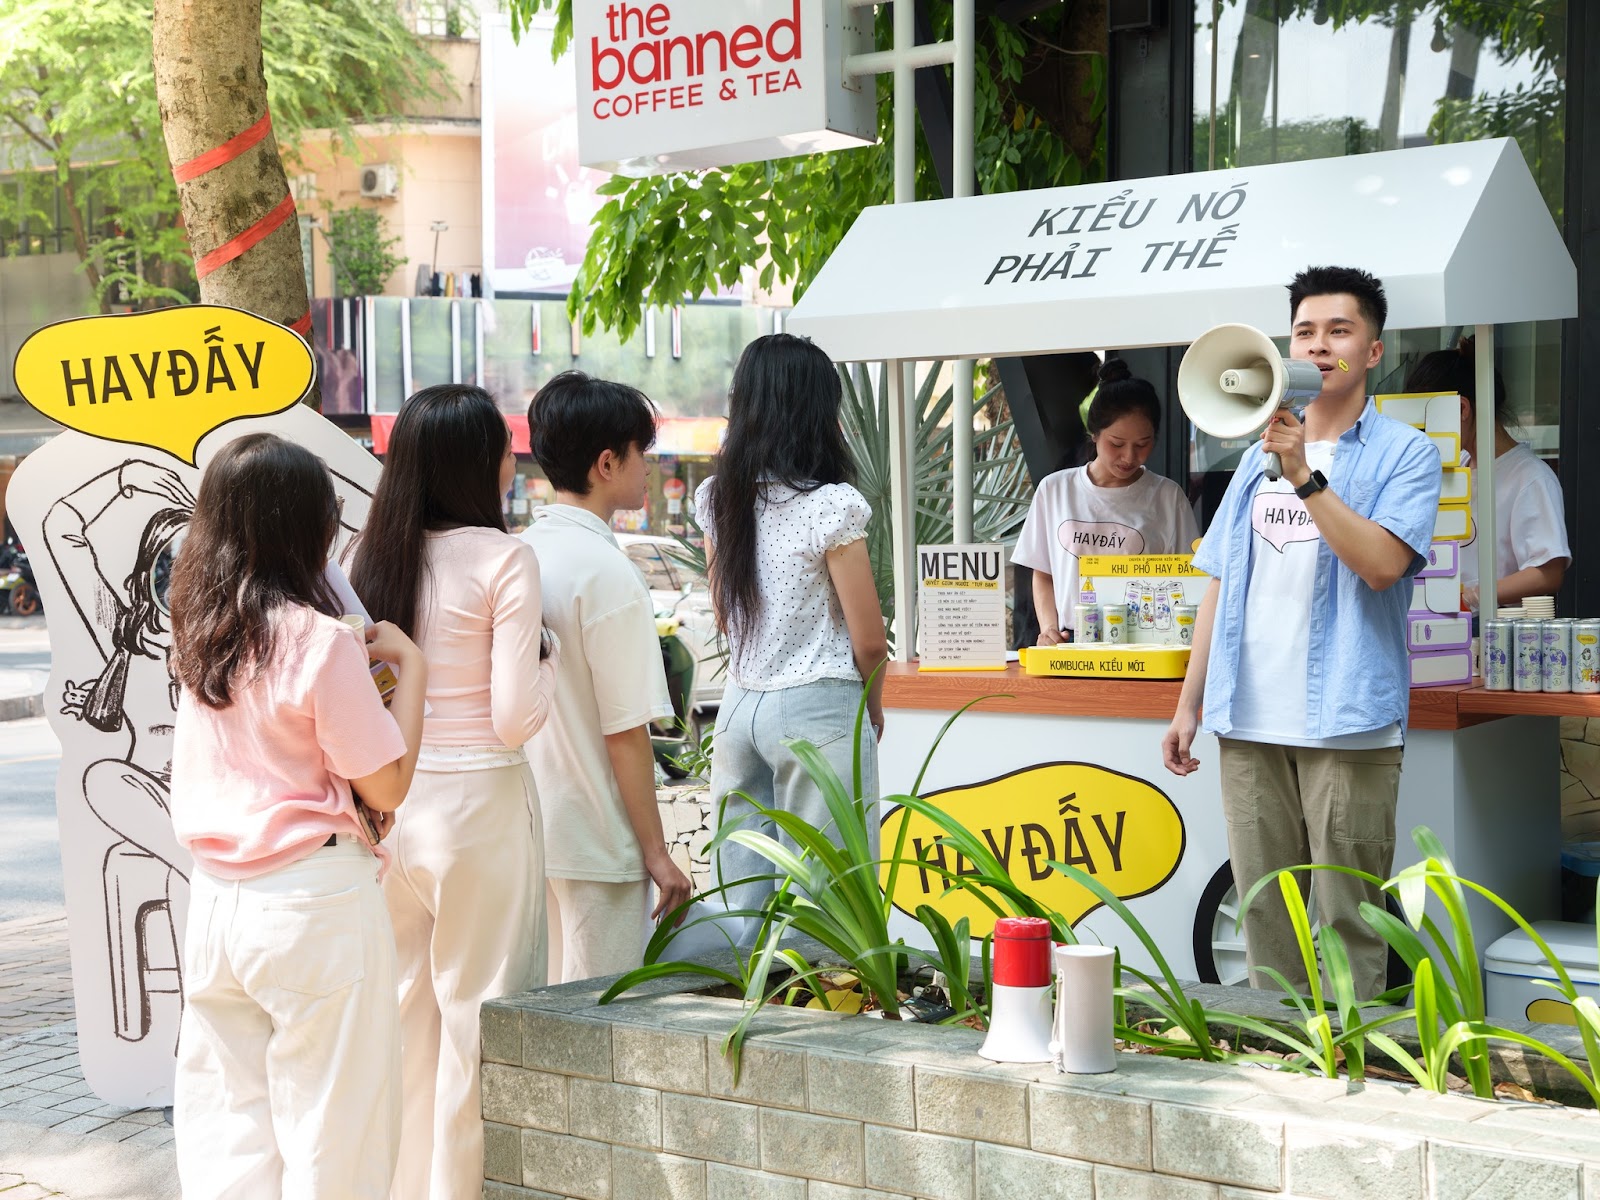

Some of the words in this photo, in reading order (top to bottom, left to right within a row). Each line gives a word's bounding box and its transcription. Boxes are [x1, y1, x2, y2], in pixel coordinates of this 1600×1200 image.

[606, 2, 670, 42] the
[592, 0, 801, 91] banned
[593, 83, 703, 120] COFFEE
[719, 78, 737, 101] &
[747, 68, 801, 96] TEA
[1028, 189, 1158, 237] KIỂU
[1176, 181, 1249, 224] NÓ
[984, 242, 1112, 285] PHẢI
[1140, 223, 1240, 273] THẾ
[60, 325, 265, 406] HAYĐẤY
[1264, 508, 1314, 526] HAYĐ
[1073, 531, 1126, 549] HAYĐẤY
[921, 552, 999, 580] MENU
[1111, 564, 1128, 574] KHU
[1133, 561, 1151, 574] PHỐ
[1155, 564, 1173, 574] HAY
[1050, 660, 1095, 671] KOMBUCHA
[1099, 657, 1123, 672] KIỂU
[1127, 659, 1145, 672] MỚI
